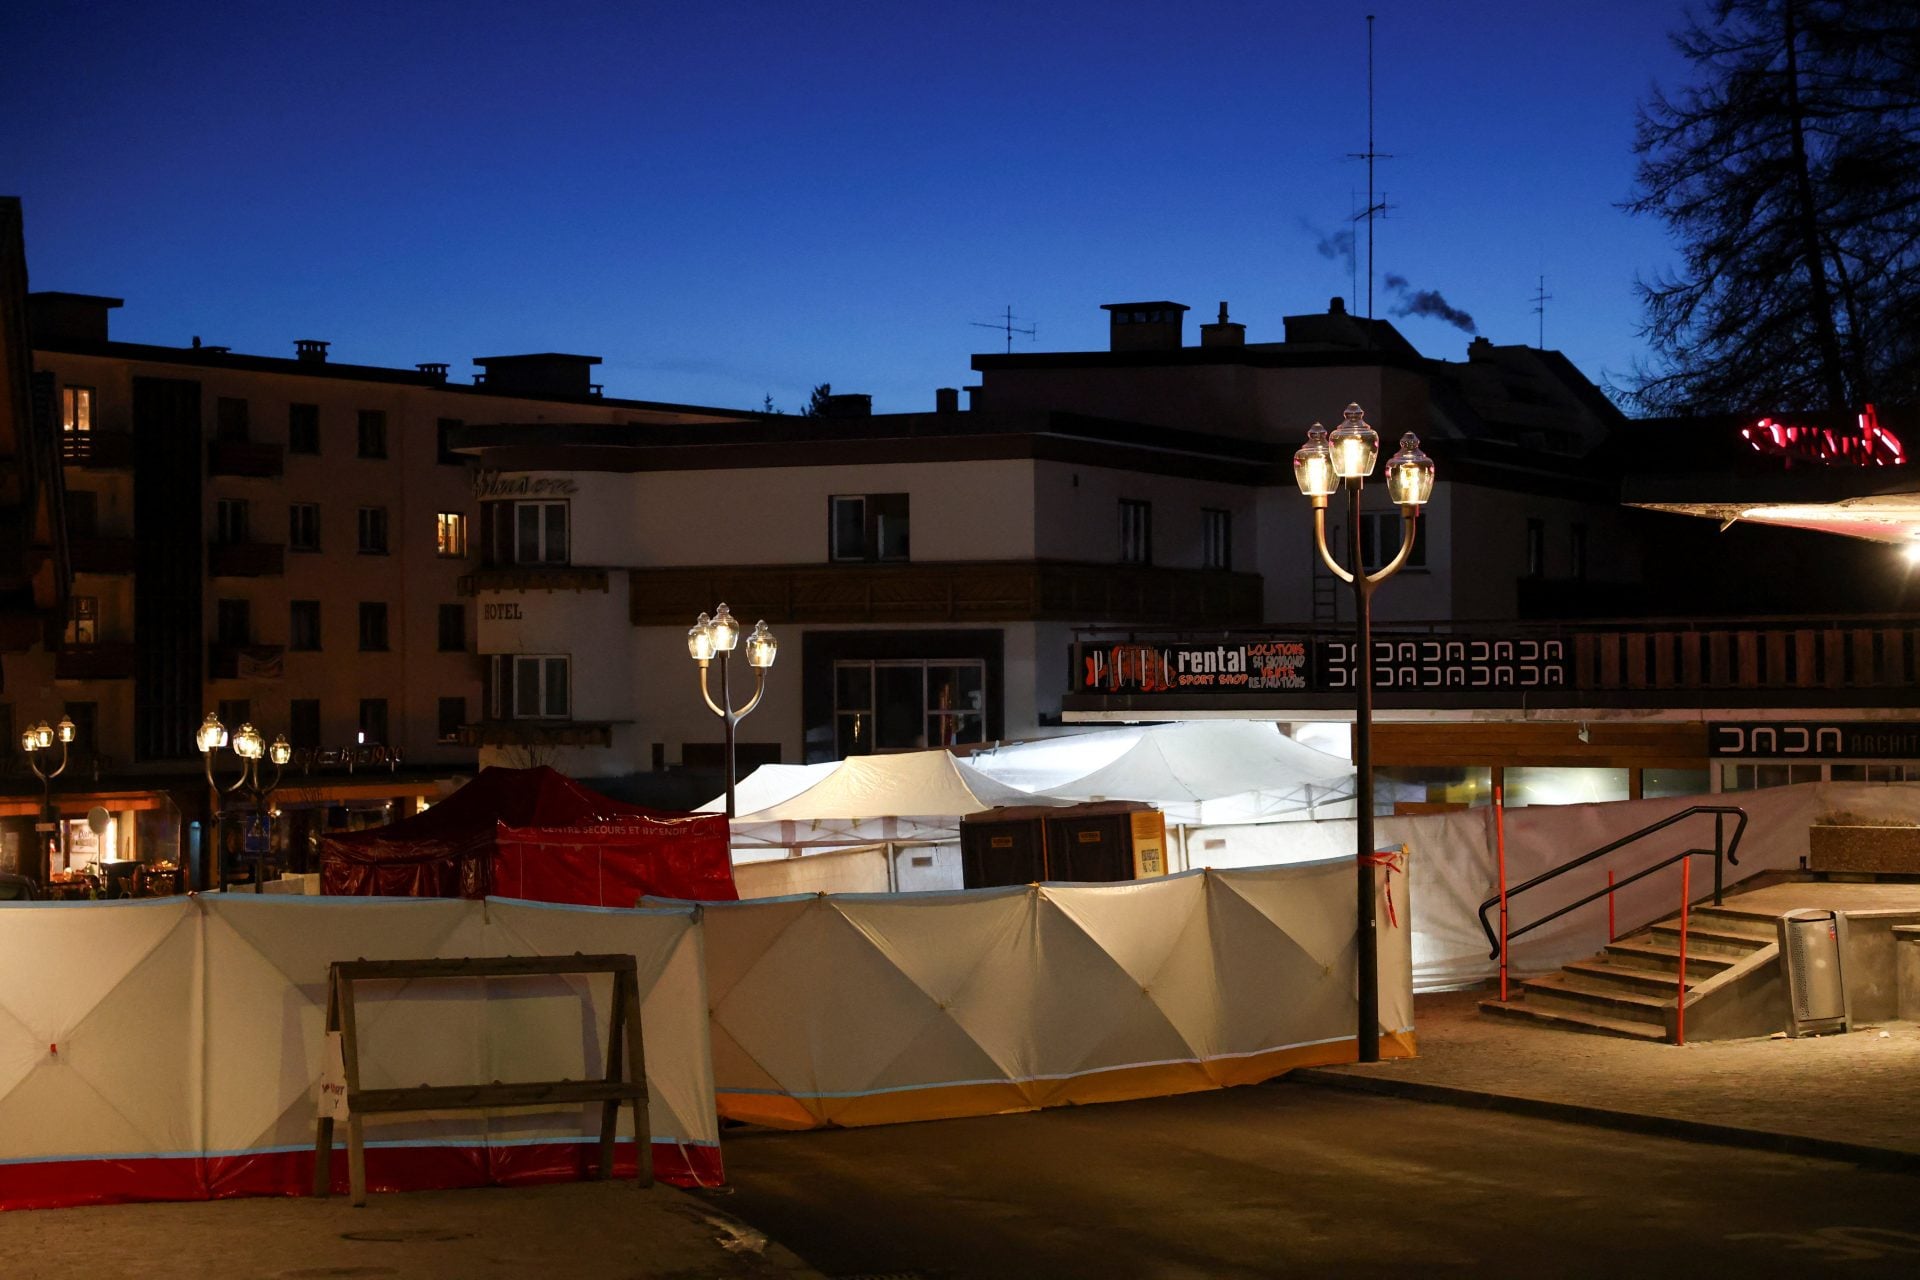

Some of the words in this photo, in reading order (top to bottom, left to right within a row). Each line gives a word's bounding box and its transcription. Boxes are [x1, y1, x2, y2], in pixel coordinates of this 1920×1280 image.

[484, 603, 522, 620] HOTEL
[1247, 643, 1305, 656] LOCATIONS
[1093, 649, 1172, 687] PACIFIC
[1178, 645, 1247, 673] rental
[1179, 674, 1215, 686] SPORT
[1218, 674, 1248, 686] SHOP
[583, 825, 626, 835] SECOURS
[629, 826, 640, 836] ET
